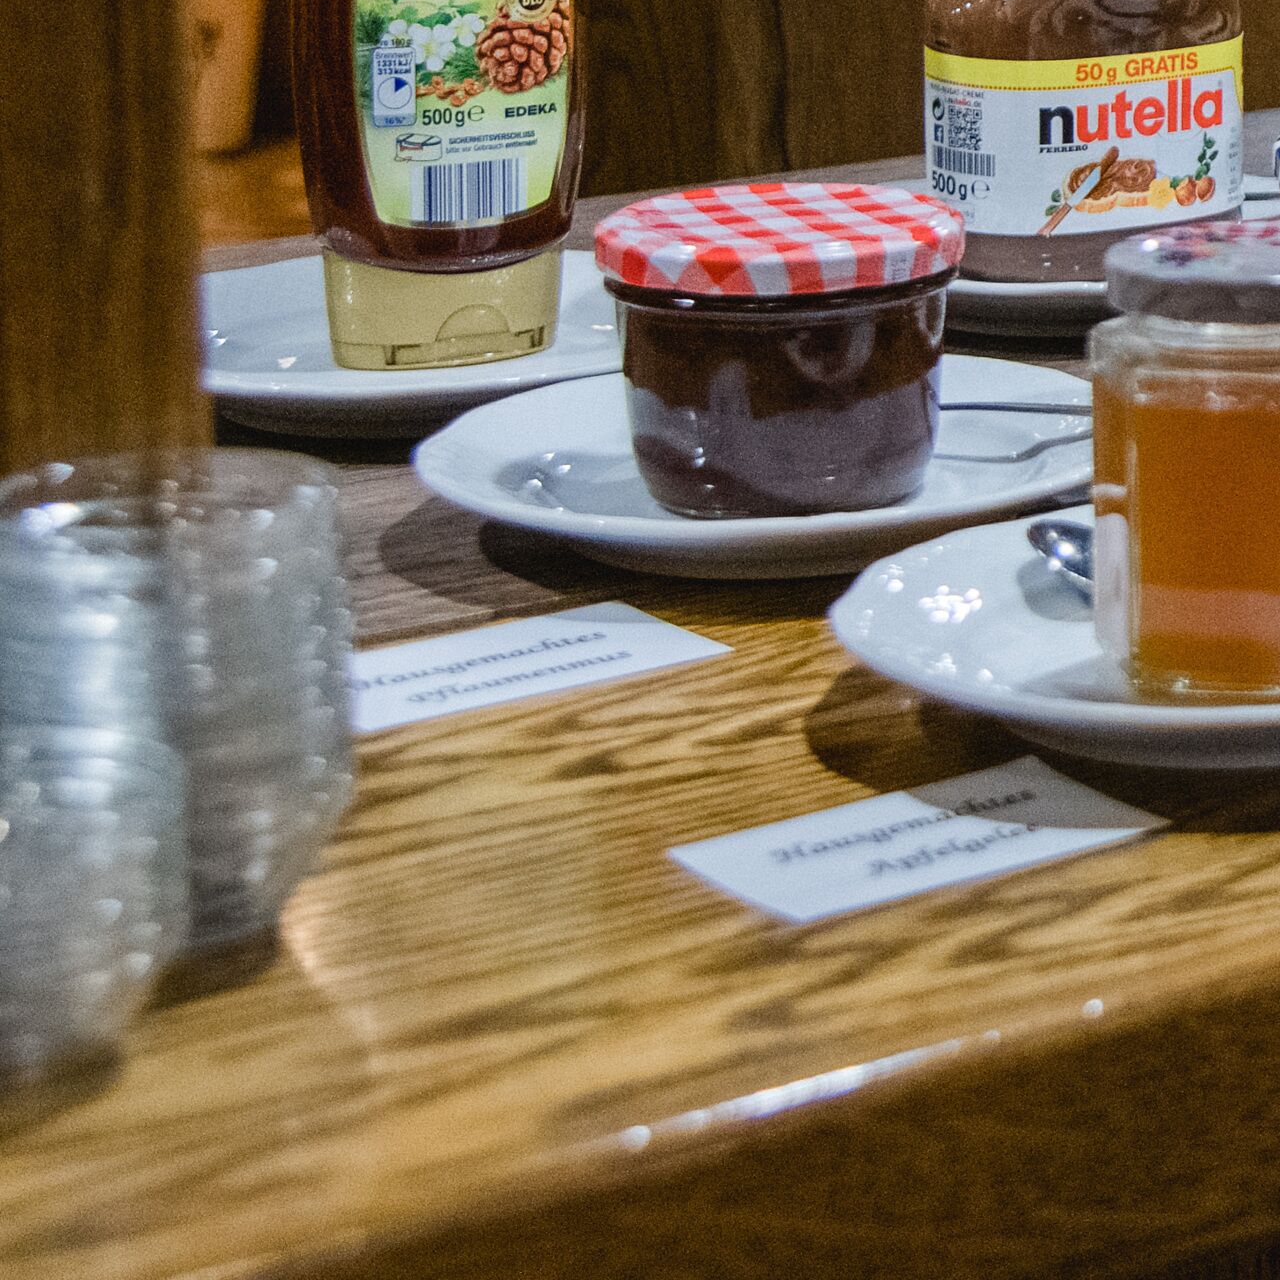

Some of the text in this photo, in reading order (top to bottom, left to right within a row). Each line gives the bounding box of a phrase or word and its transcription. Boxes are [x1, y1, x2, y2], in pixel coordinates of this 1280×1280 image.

[1124, 52, 1198, 78] GRATIS
[504, 102, 558, 119] EDEKA
[1039, 77, 1223, 145] nutella
[1039, 143, 1089, 154] FERRERO
[408, 649, 633, 703] Pflaumenmus
